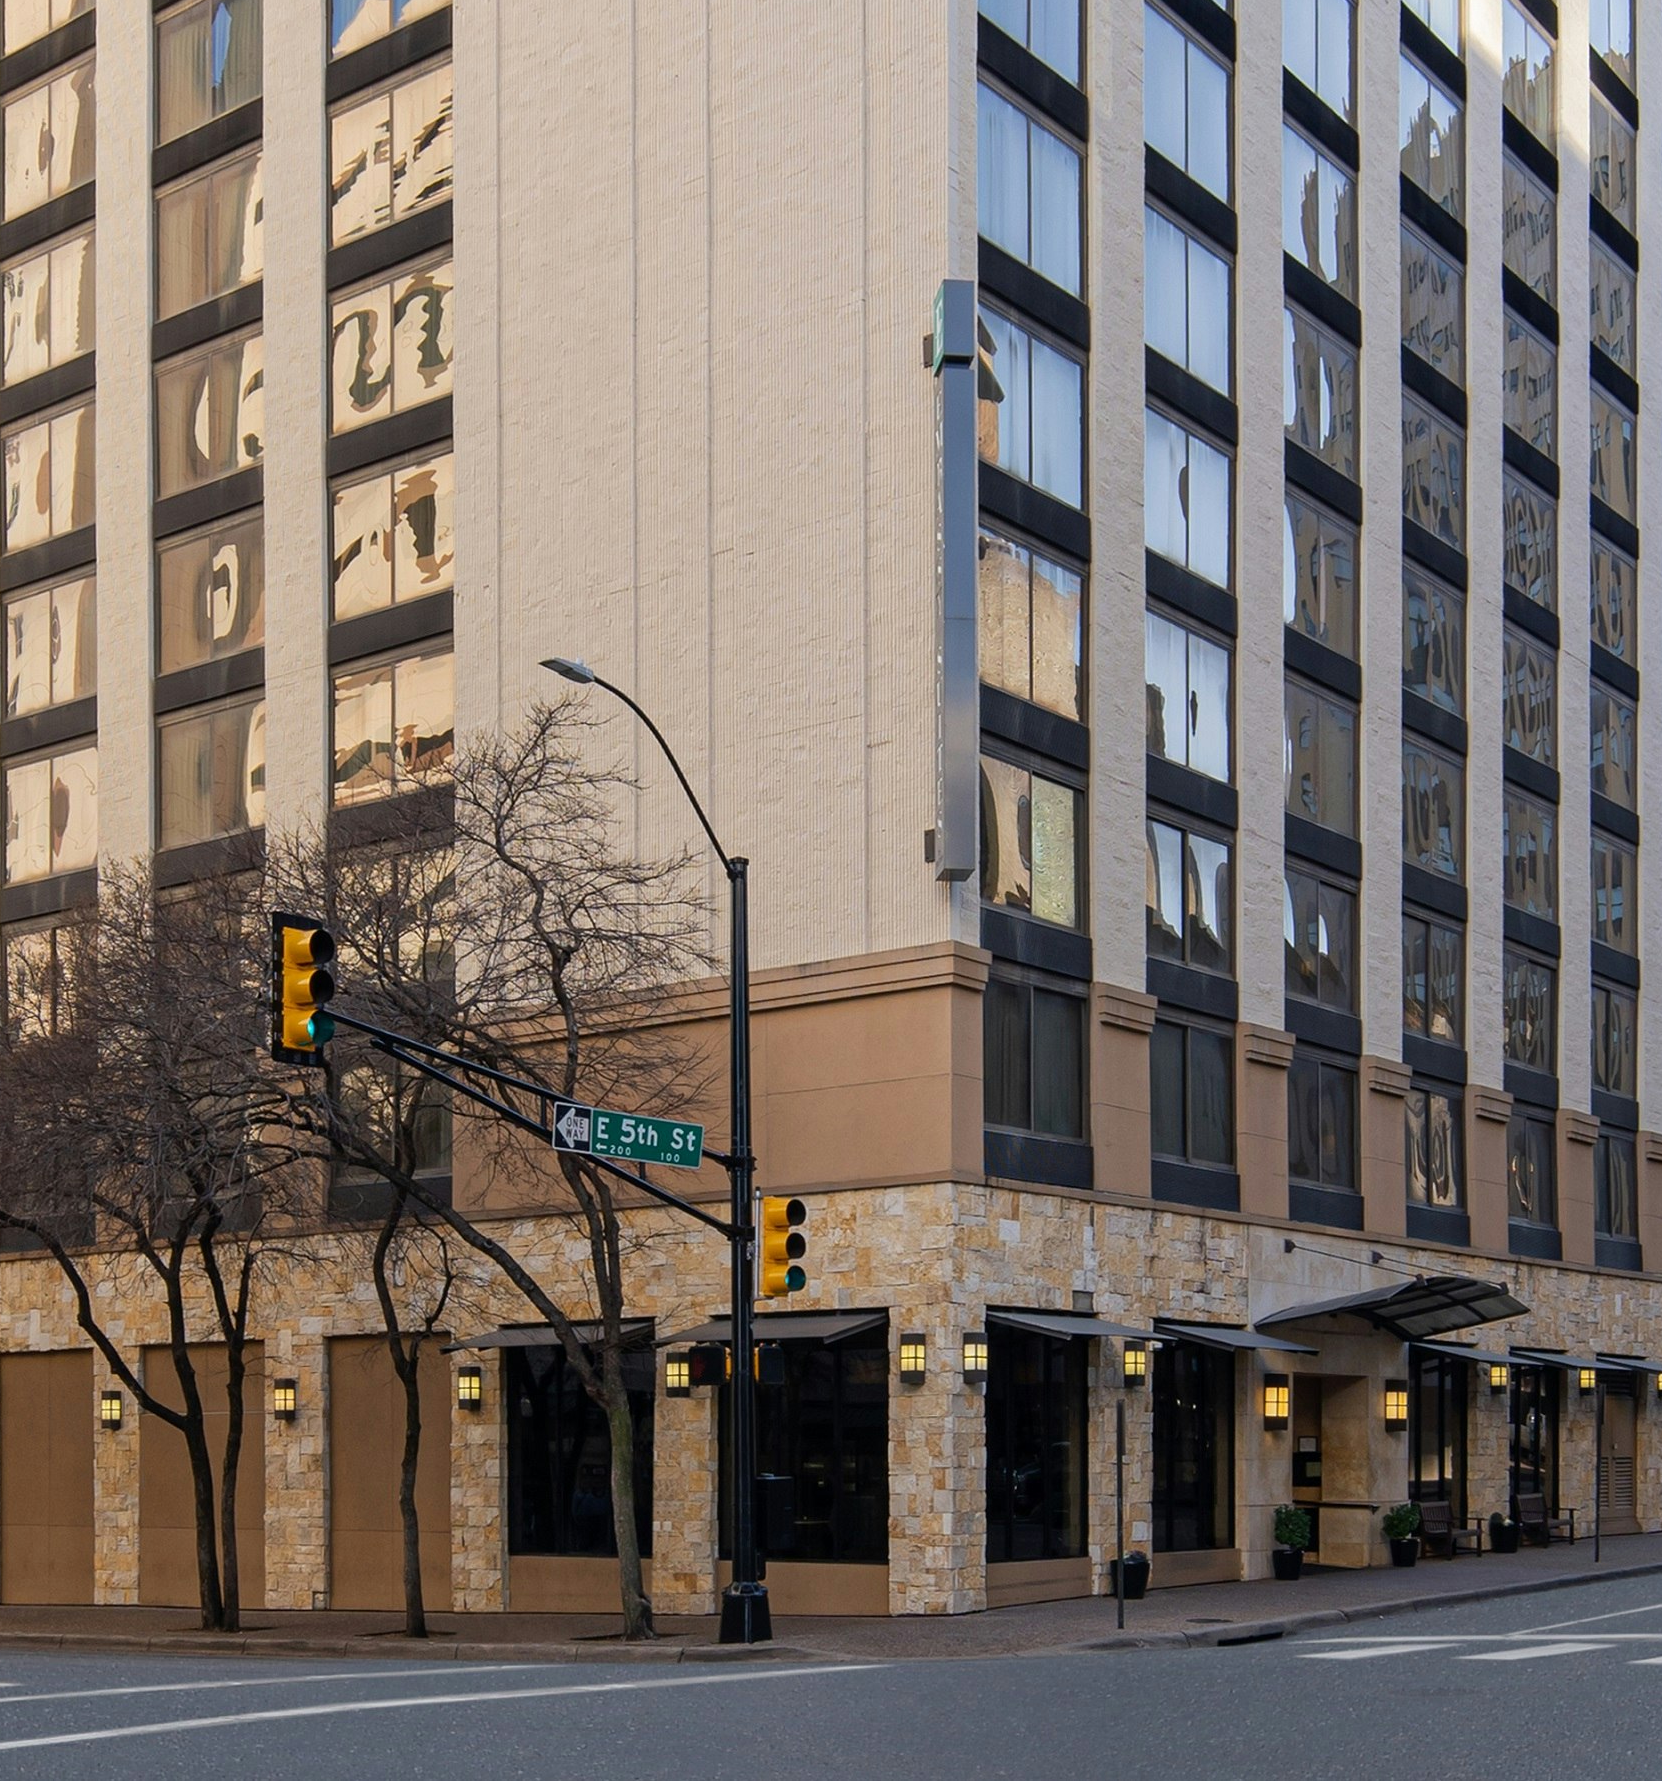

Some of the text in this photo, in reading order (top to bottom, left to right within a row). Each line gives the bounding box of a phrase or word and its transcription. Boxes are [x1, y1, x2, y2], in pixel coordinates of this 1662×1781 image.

[566, 1116, 584, 1129] ONE
[566, 1128, 584, 1140] WAY
[597, 1117, 696, 1151] E 5th St
[609, 1145, 680, 1163] 200 100
